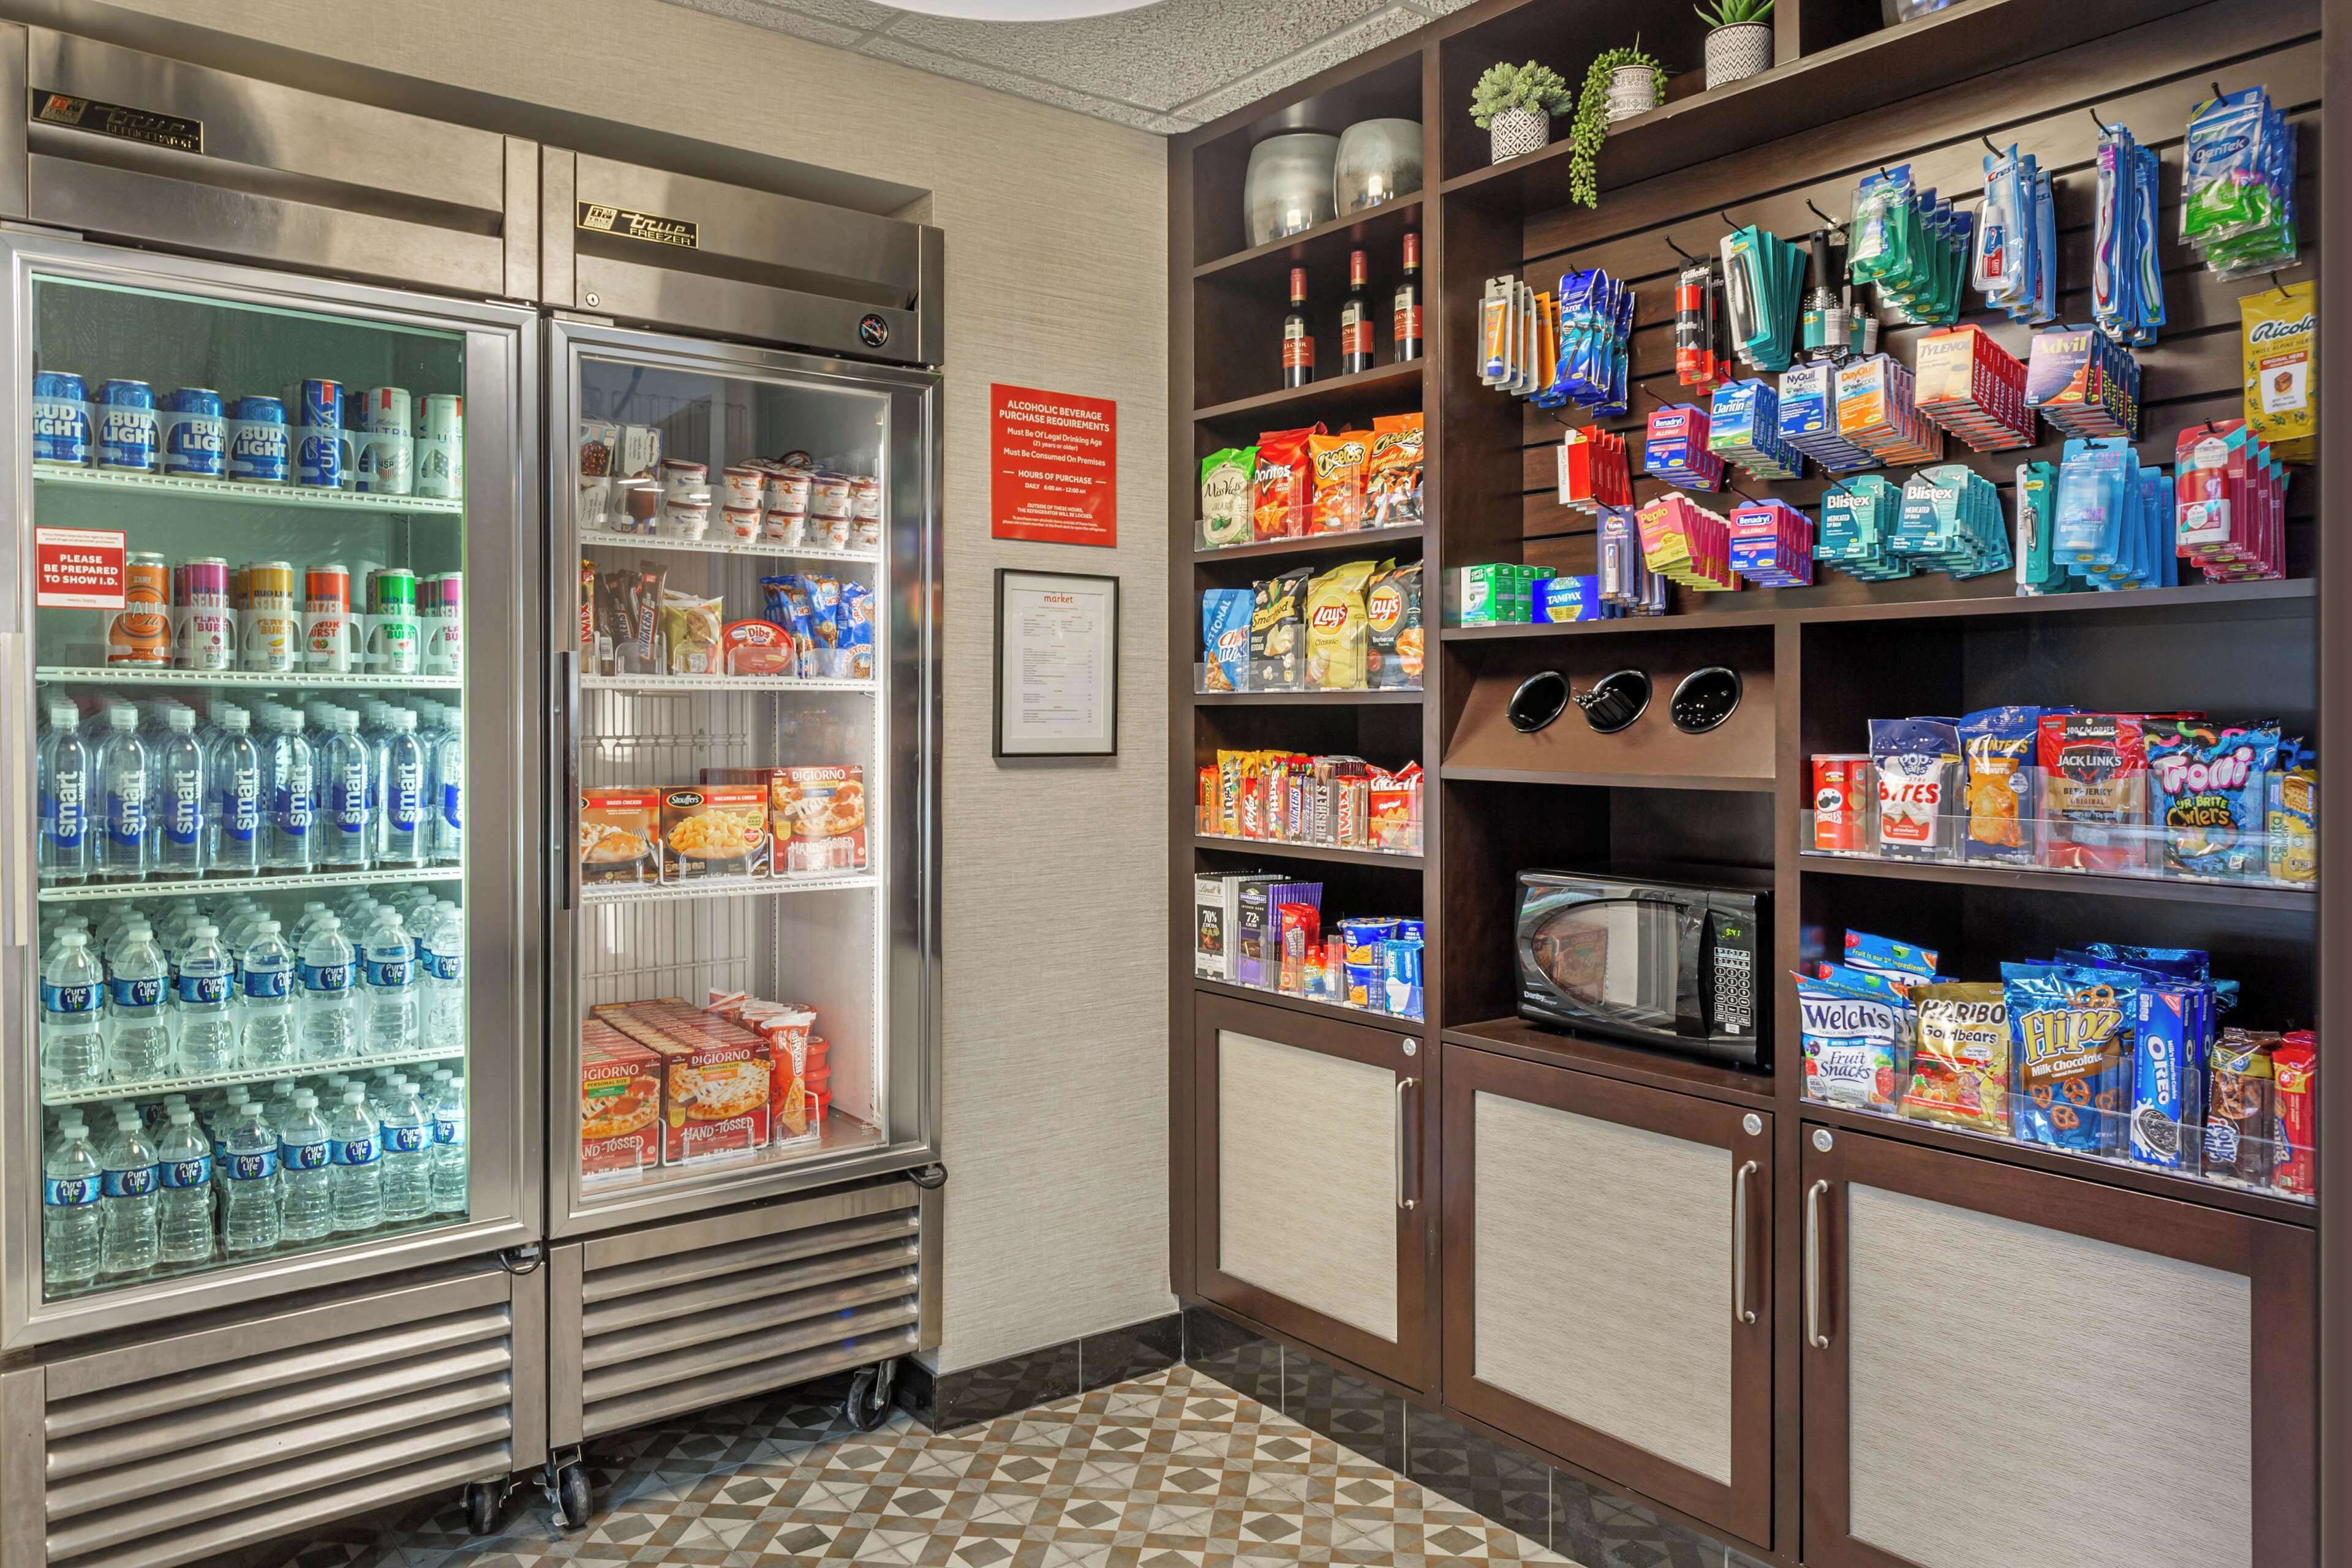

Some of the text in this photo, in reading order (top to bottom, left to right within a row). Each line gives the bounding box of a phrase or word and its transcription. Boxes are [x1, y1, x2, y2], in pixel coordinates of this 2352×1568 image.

[2196, 137, 2245, 161] DenTek
[1988, 163, 2017, 182] Crest
[630, 228, 690, 245] FREEZER
[1681, 266, 1709, 280] Gillette
[2252, 314, 2318, 342] Ricola
[1920, 339, 1970, 358] TYLENOL
[2037, 336, 2086, 354] Advil
[2252, 342, 2293, 355] SWISS ALPINE
[2263, 356, 2287, 365] ORIGINAL
[1787, 370, 1815, 384] NyQuil
[1841, 364, 1876, 382] DayQuil
[1008, 400, 1102, 420] ALCOHOLIC BEVERAGE
[1713, 401, 1744, 414] Claritin
[110, 412, 153, 428] BUD
[1000, 410, 1109, 432] PURCHASE REQUIREMENTS
[1655, 417, 1684, 428] Benadryl
[104, 426, 155, 445] LIGHT
[241, 426, 282, 441] BUD
[321, 410, 334, 469] ULTRA
[1008, 428, 1024, 436] Must
[1044, 432, 1061, 441] Legal
[1063, 434, 1089, 445] Drinking
[1090, 438, 1102, 447] Age
[238, 441, 286, 457] LIGHT
[1004, 448, 1020, 456] Must
[1031, 451, 1066, 462] Consumed
[1077, 456, 1106, 466] Premises
[1018, 470, 1043, 479] HOURS
[1055, 474, 1092, 484] PURCHASE
[1204, 483, 1225, 498] Miss
[1907, 486, 1953, 503] Blistex
[1827, 496, 1870, 510] Blistex
[1640, 507, 1668, 524] Pepto
[1739, 513, 1770, 525] Benadryl
[60, 554, 102, 564] PLEASE
[61, 565, 118, 575] PREPARED
[62, 575, 97, 584] SHOW
[100, 577, 118, 586] I.D.
[1044, 592, 1073, 604] market
[1547, 592, 1581, 605] TAMPAX
[123, 601, 164, 624] PALE
[1369, 595, 1401, 620] Lay's
[1314, 605, 1348, 627] Lay's
[639, 608, 654, 660] SNICKERS
[748, 626, 771, 639] Dibs
[2057, 755, 2122, 766] JACK LINK'S
[793, 769, 845, 781] DIGIORNO
[2154, 746, 2255, 793] Trolli
[235, 768, 254, 830] smart
[290, 763, 306, 826] smart
[343, 763, 361, 824] smart
[398, 763, 416, 823] smart
[671, 795, 699, 805] Stouffer's
[56, 771, 77, 837] smart
[121, 770, 142, 836] smart
[175, 770, 195, 834] smart
[2196, 796, 2228, 809] BRITE
[1291, 789, 1300, 832] SNICKERS
[1315, 785, 1327, 840] HERSHEY'S
[1338, 788, 1352, 837] TWIX
[1817, 810, 1842, 824] PRINGLES
[1199, 883, 1216, 892] Lindt
[1203, 910, 1217, 922] 70%
[386, 963, 405, 972] Pure
[441, 957, 459, 965] Pure
[1852, 948, 1866, 957] Fruit
[1893, 959, 1926, 973] ingredient!
[325, 967, 344, 976] Pure
[388, 970, 402, 979] Life
[442, 964, 456, 973] Life
[137, 981, 158, 990] Pure
[328, 974, 342, 983] Life
[67, 995, 84, 1005] Life
[139, 989, 156, 998] Life
[1523, 991, 1545, 1004] Danby
[1803, 1004, 1891, 1030] Welch's
[1921, 1000, 2005, 1023] HARIBO
[2022, 1009, 2122, 1065] Flipz
[692, 1050, 750, 1065] DIGIORNO
[1830, 1051, 1866, 1065] Fruit
[2031, 1053, 2103, 1077] Milk Chocolate
[1820, 1061, 1870, 1079] Snacks
[2147, 1035, 2169, 1105] OREO
[127, 1169, 147, 1179] Pure
[61, 1180, 82, 1189] Pure
[129, 1177, 145, 1187] Life
[62, 1188, 79, 1197] Life
